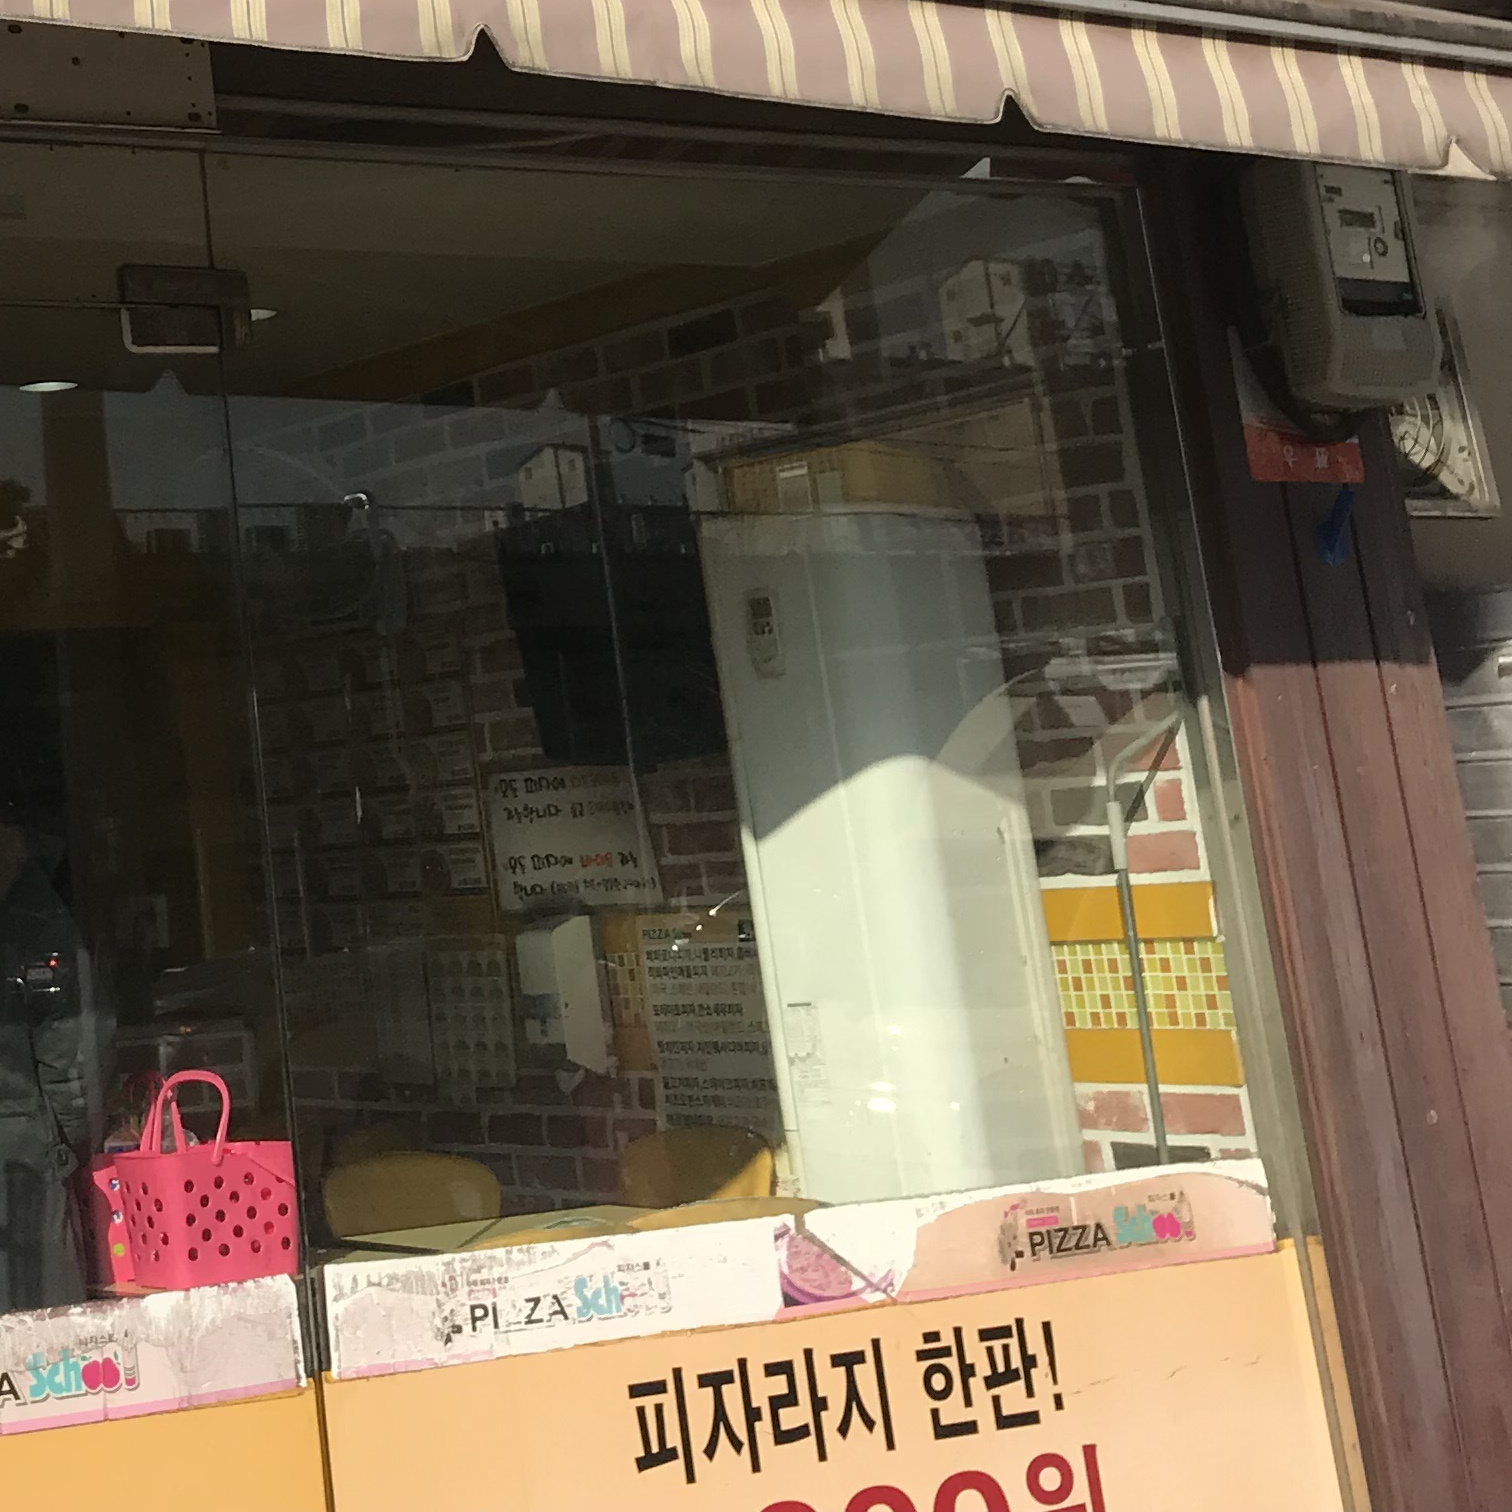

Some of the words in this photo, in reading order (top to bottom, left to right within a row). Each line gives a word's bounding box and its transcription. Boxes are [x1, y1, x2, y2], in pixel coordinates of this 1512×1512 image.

[1028, 1222, 1111, 1257] PIZZA
[469, 1293, 569, 1332] PIZA
[628, 1337, 896, 1485] 피자라지
[915, 1317, 1065, 1440] 한판!
